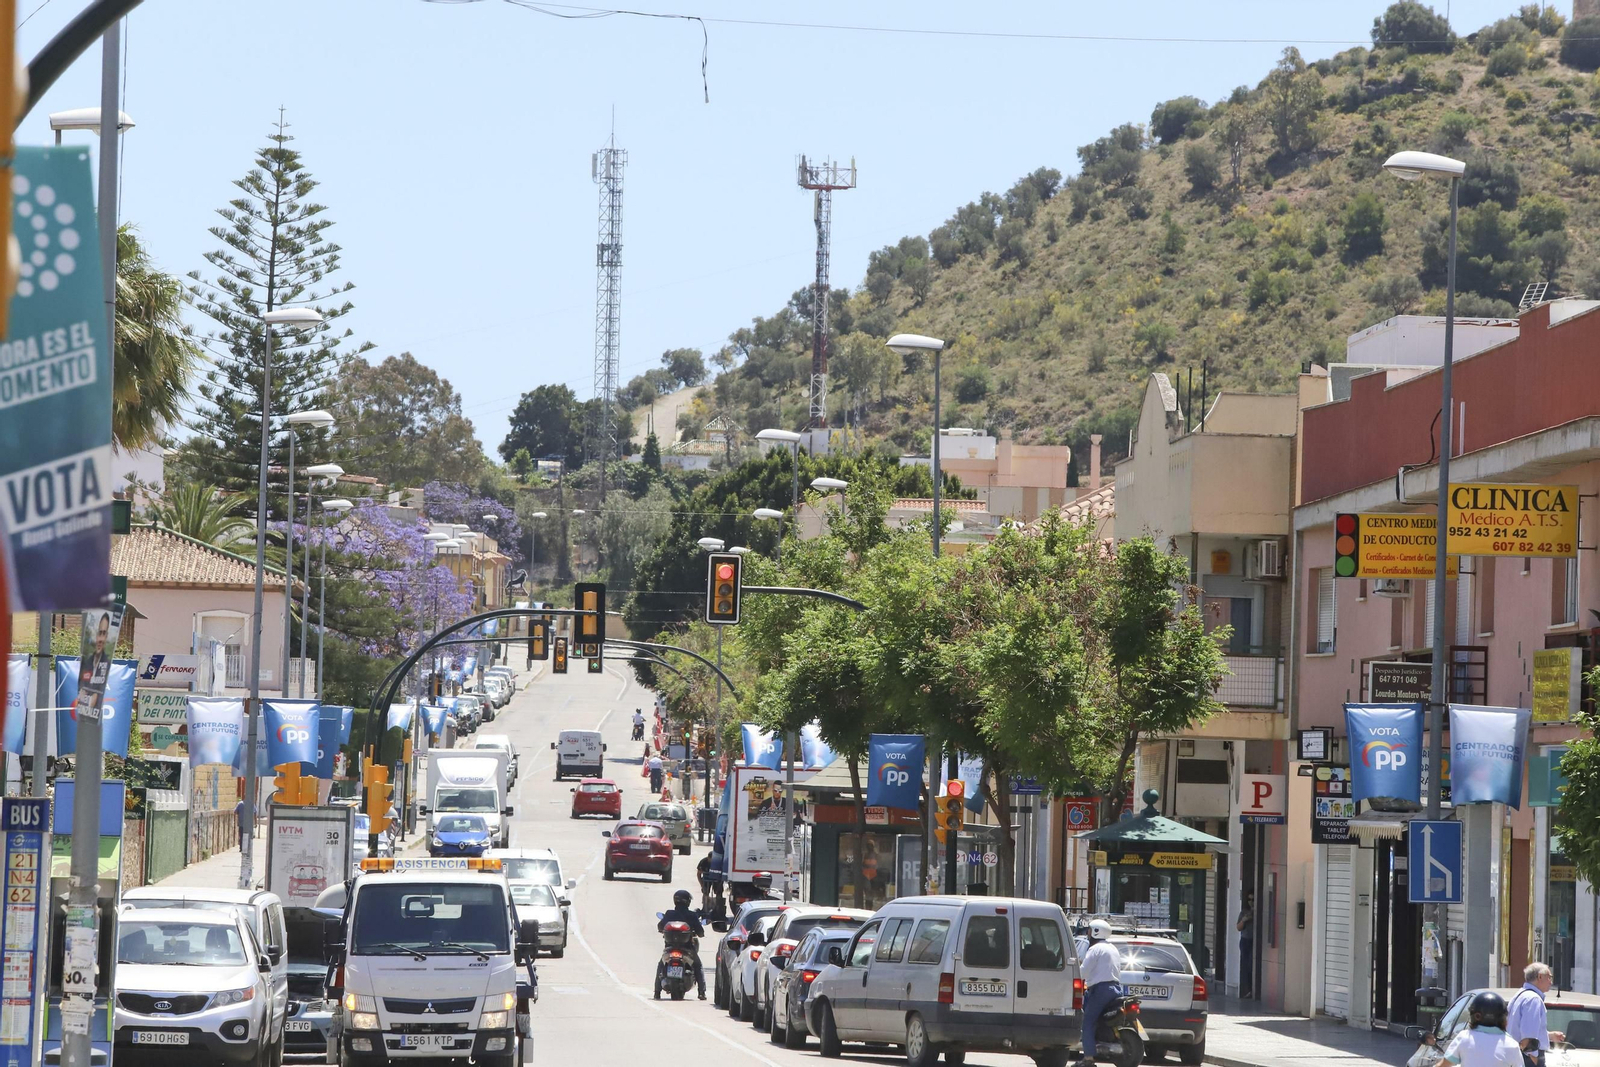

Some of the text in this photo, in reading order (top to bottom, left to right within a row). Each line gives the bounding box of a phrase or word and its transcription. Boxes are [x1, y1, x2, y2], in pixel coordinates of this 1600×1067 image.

[42, 327, 68, 357] ES
[70, 320, 95, 348] EL
[7, 457, 101, 524] VOTA
[1452, 487, 1569, 512] CLINICA
[1367, 518, 1438, 528] CENTRO MEDI
[1518, 513, 1563, 527] A.T.S.
[1449, 527, 1527, 538] 952 43 21 42
[1363, 535, 1376, 544] DE
[1493, 542, 1571, 552] 607 82 42 39
[1400, 554, 1417, 562] Carnet
[1379, 675, 1390, 683] 647
[1392, 676, 1403, 684] 971
[1376, 689, 1432, 701] Lourdes Montero Verg
[163, 709, 187, 719] PINT
[192, 722, 239, 730] CENTRADOS
[1369, 728, 1400, 736] VOTA
[1456, 742, 1520, 754] CENTRADOS
[1482, 751, 1519, 762] FUTURO
[1252, 782, 1272, 808] P
[10, 804, 40, 826] BUS
[326, 832, 339, 840] 30
[16, 854, 33, 868] 21
[396, 860, 466, 868] ASISTENCIA
[968, 854, 981, 862] N4
[984, 854, 997, 864] 62
[10, 888, 30, 902] 62
[968, 984, 988, 992] 8355
[1129, 986, 1150, 994] 5644
[292, 1022, 310, 1030] FVG
[140, 1032, 186, 1044] 6910 HGS
[407, 1036, 452, 1045] 5561 KTP
